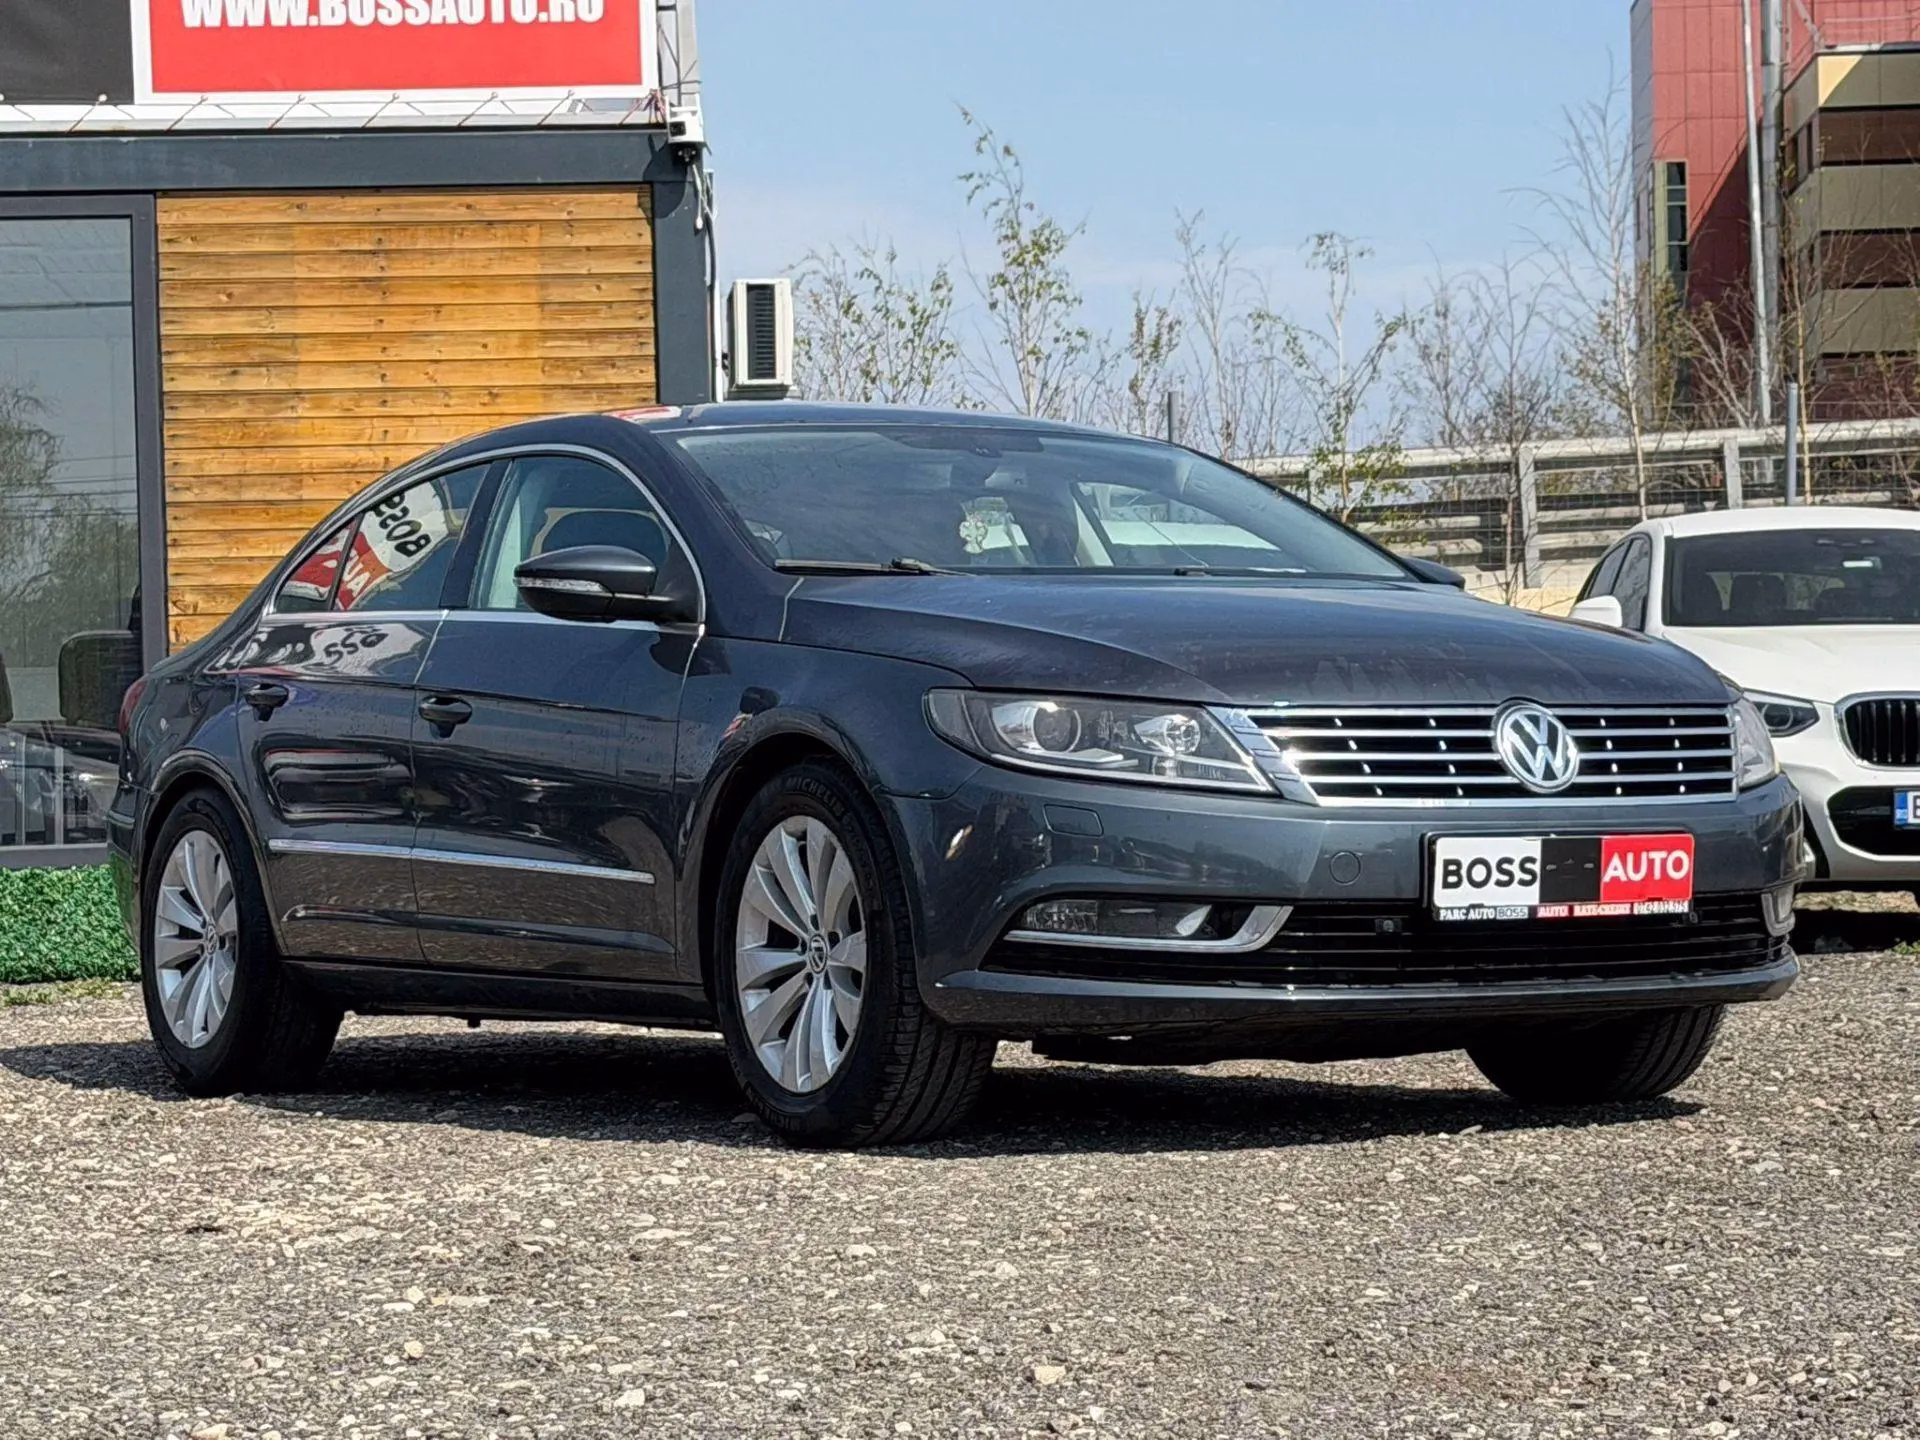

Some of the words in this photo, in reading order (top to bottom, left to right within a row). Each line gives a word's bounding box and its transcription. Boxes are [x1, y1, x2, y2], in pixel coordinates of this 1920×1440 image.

[1442, 856, 1538, 889] BOSS
[1602, 850, 1690, 883] AUTO
[1440, 908, 1467, 920] PARC
[1467, 907, 1495, 919] AUTO
